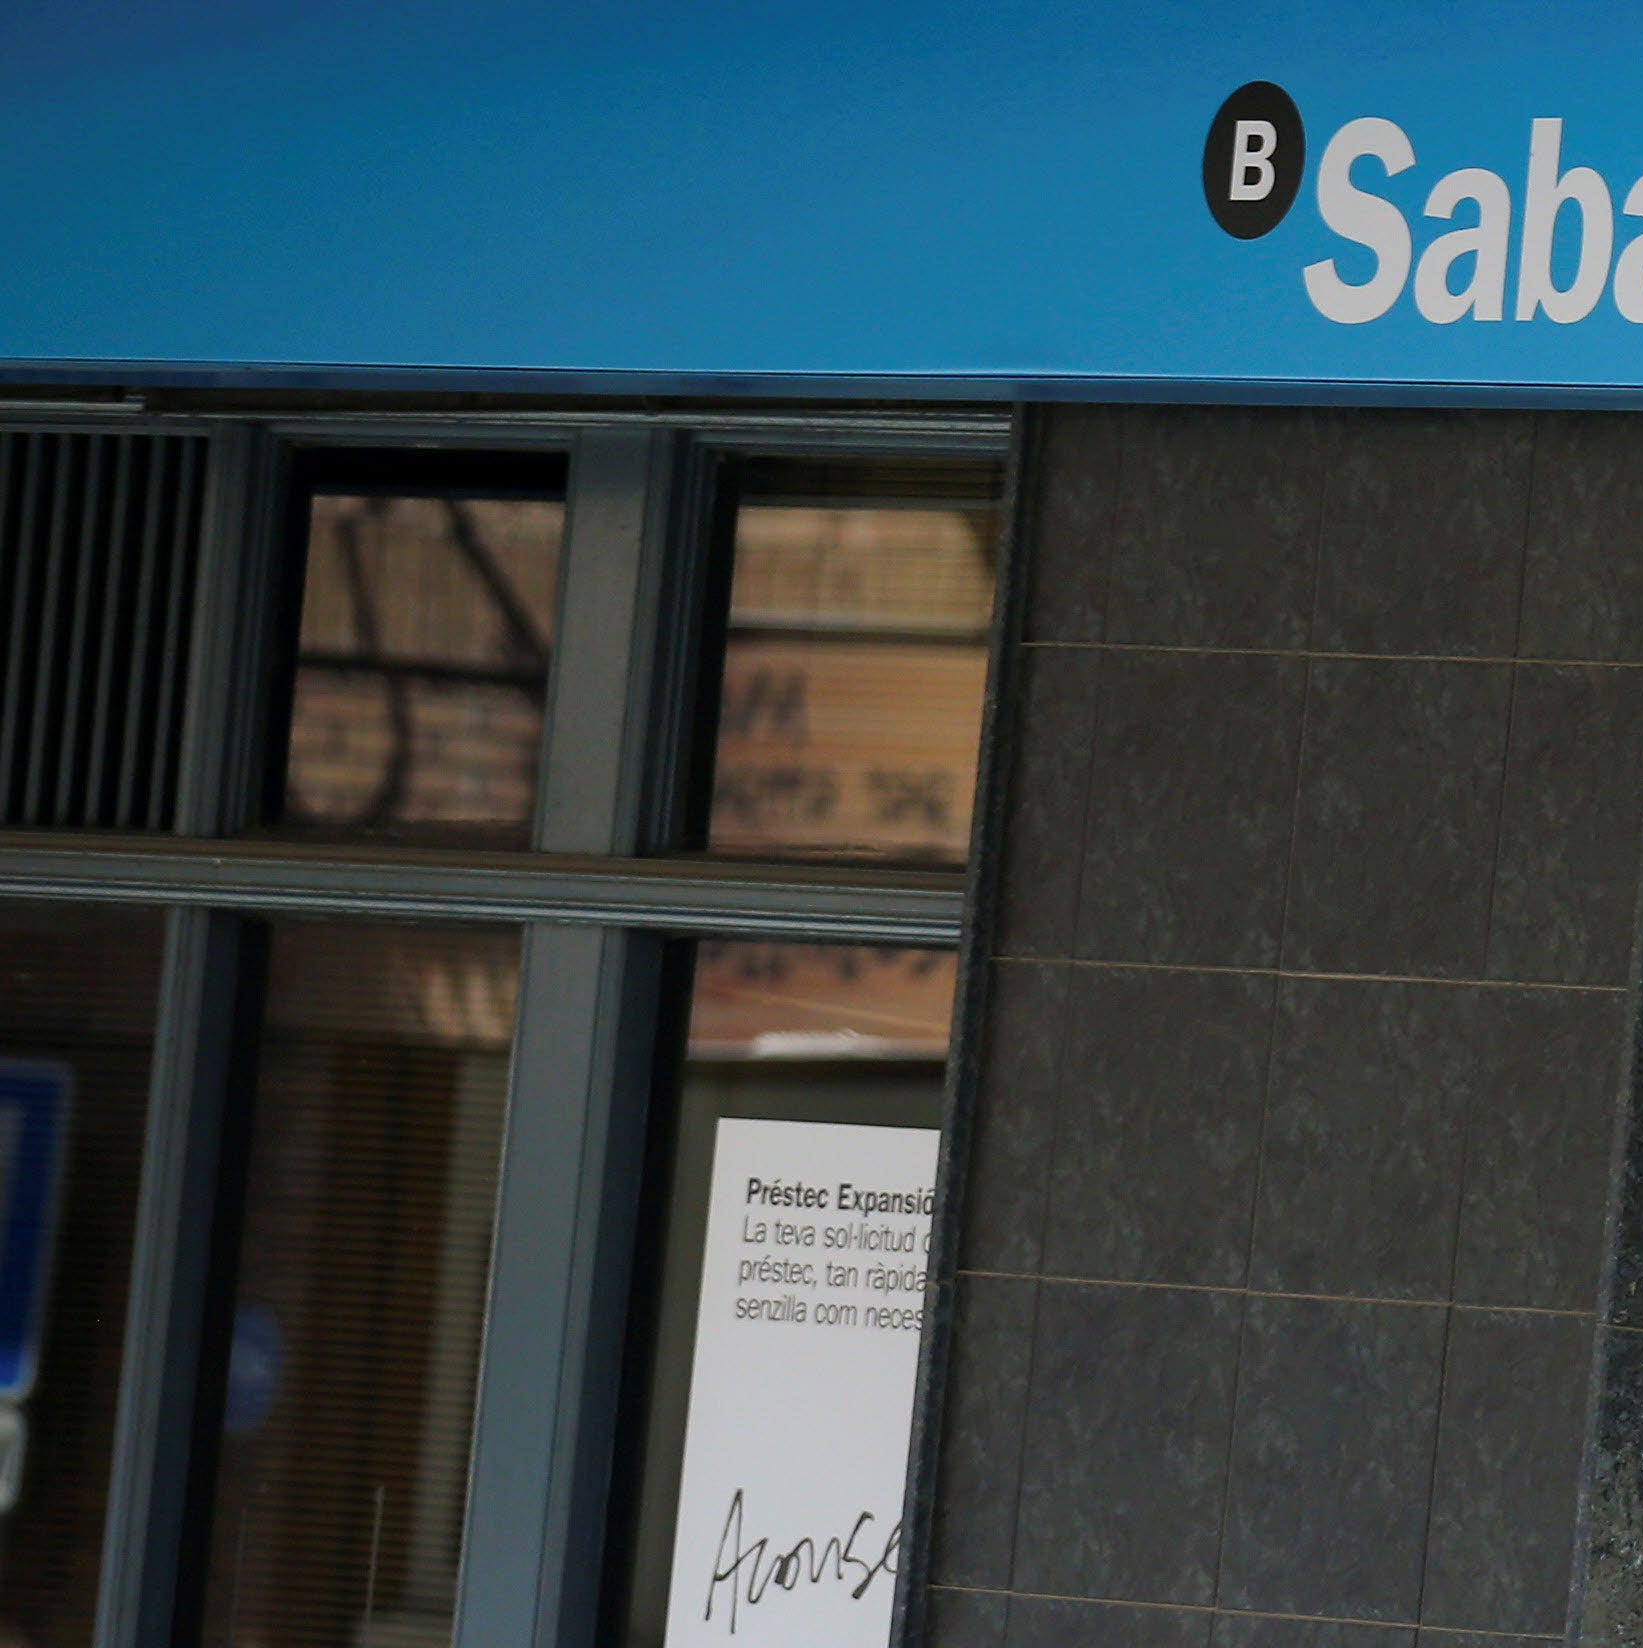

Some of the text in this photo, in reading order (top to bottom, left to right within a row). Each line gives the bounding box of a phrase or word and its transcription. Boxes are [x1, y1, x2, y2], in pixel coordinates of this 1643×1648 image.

[1229, 119, 1278, 202] B
[745, 1177, 936, 1217] Préstec Expansió
[742, 1216, 767, 1244] La
[774, 1219, 816, 1247] teva
[737, 1255, 928, 1300] préstec, tan ràpida
[735, 1295, 807, 1324] senzilla
[815, 1301, 858, 1327] com
